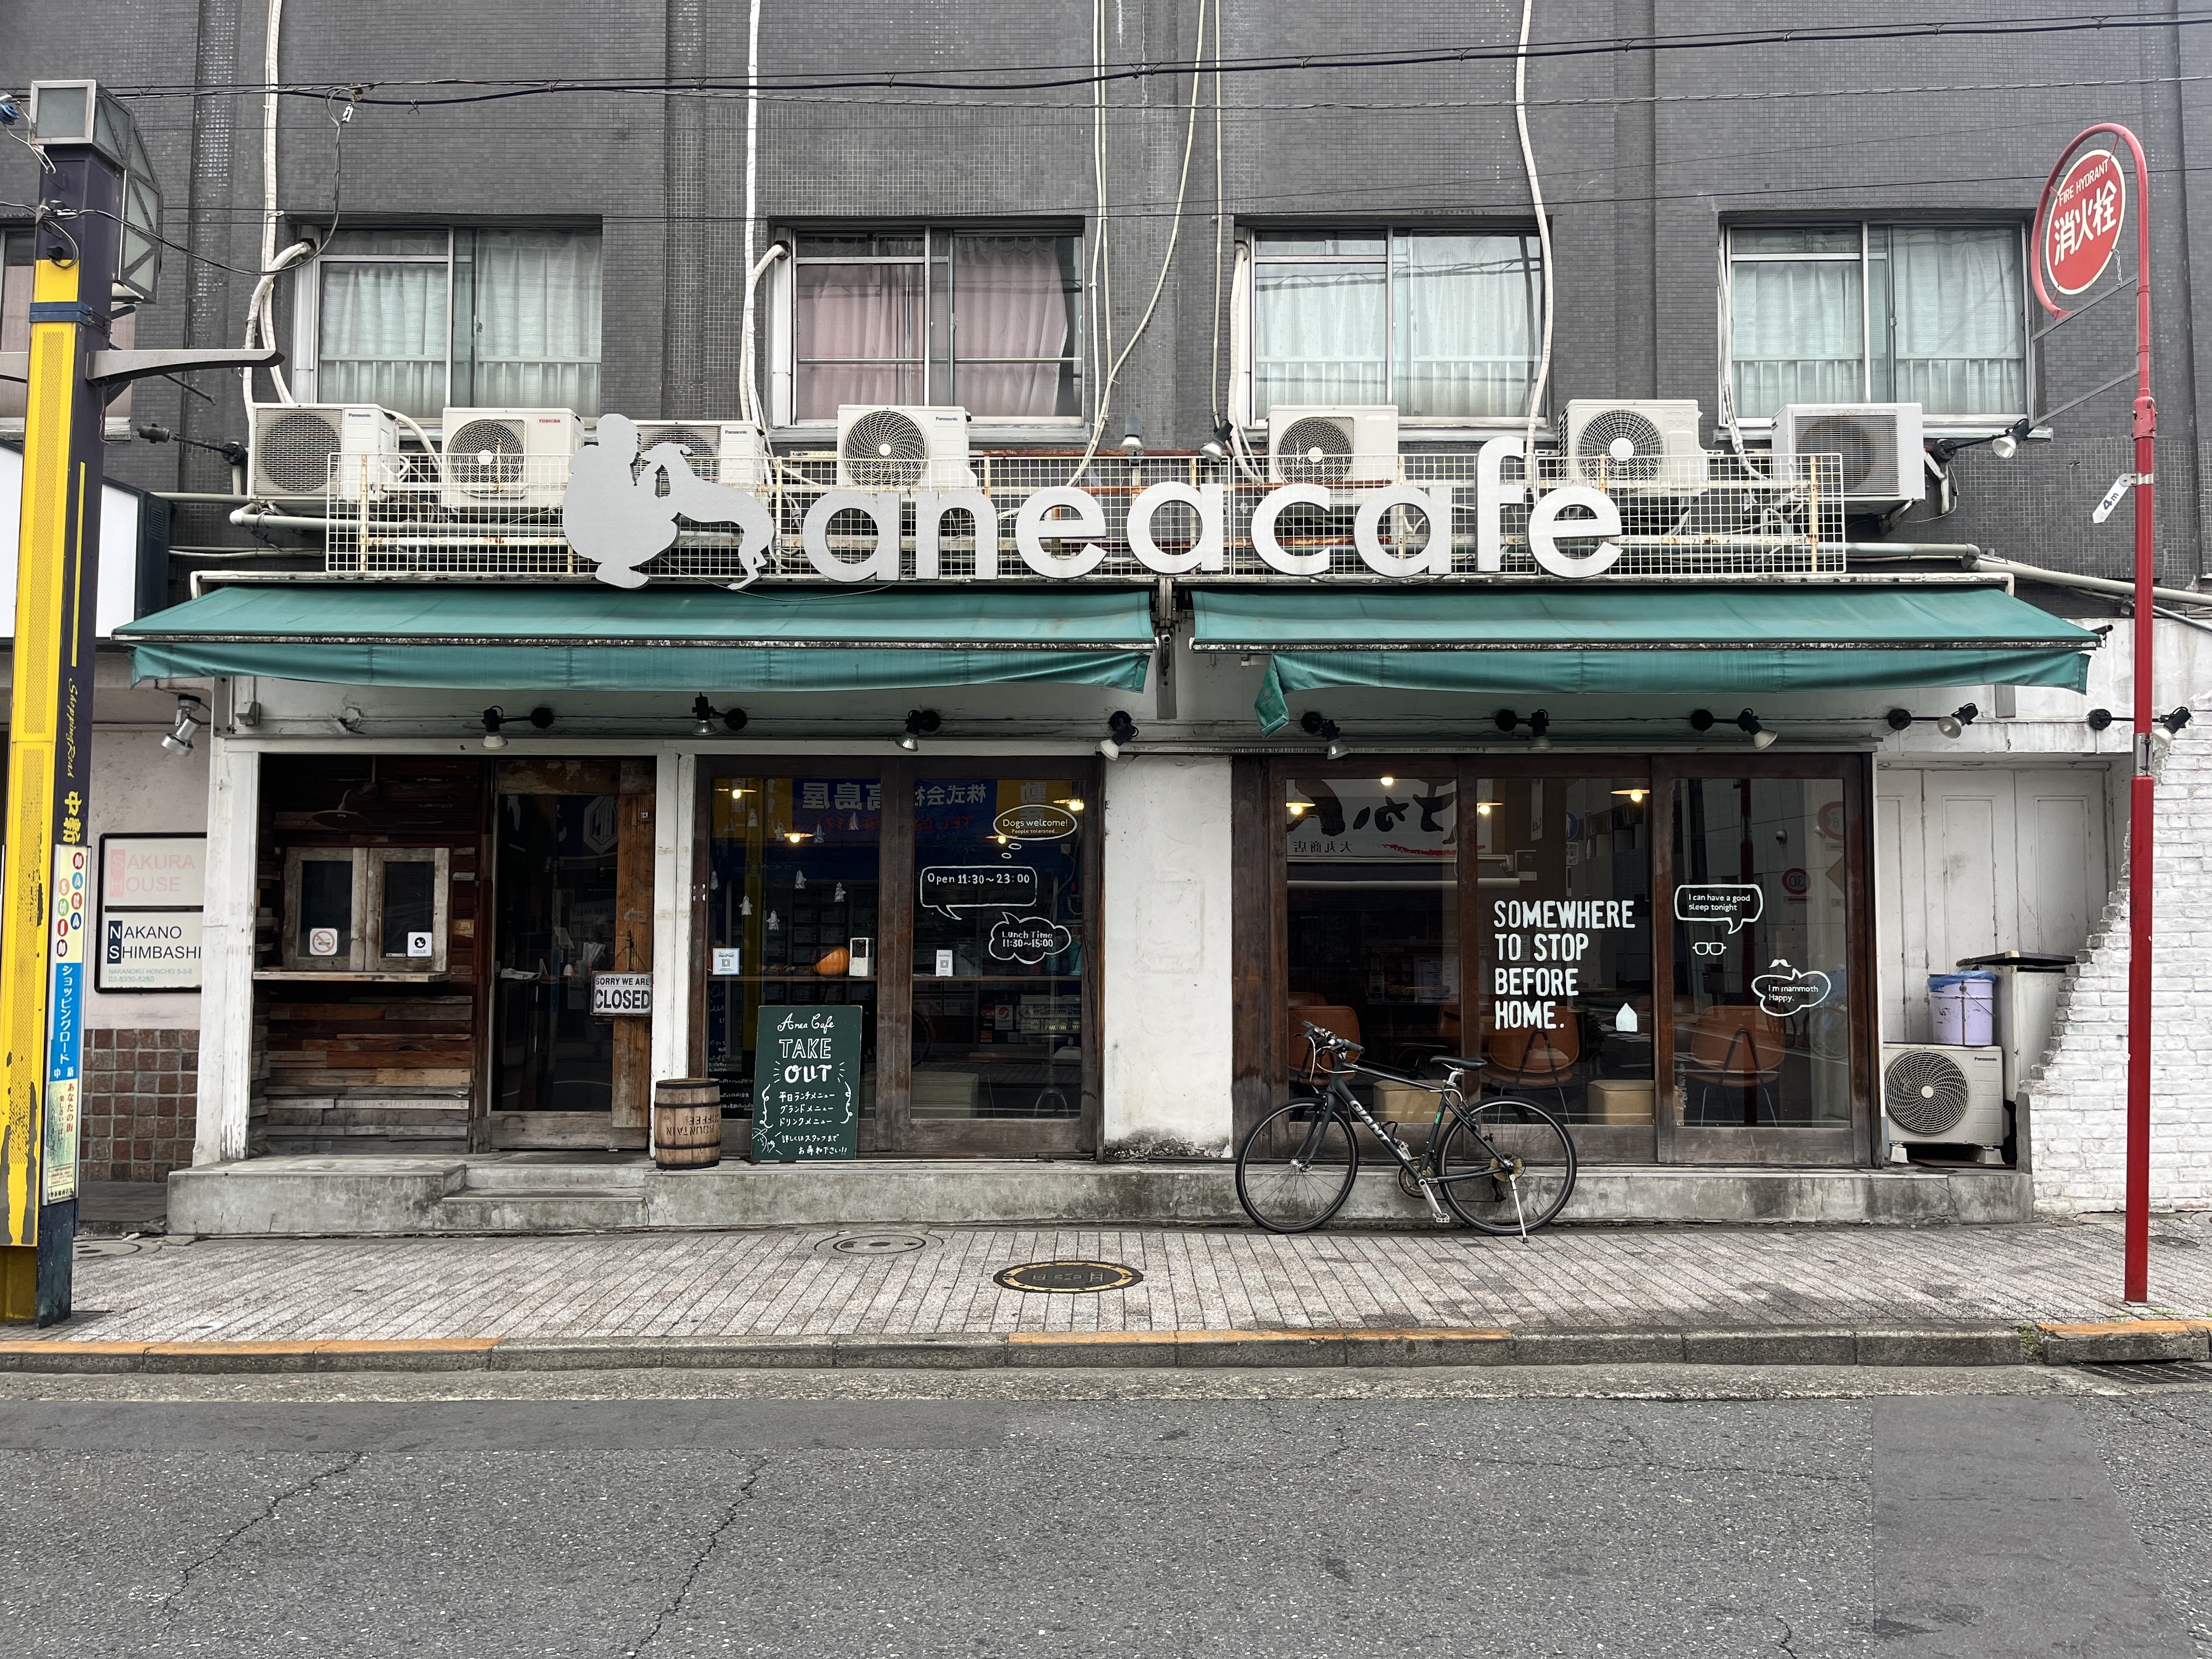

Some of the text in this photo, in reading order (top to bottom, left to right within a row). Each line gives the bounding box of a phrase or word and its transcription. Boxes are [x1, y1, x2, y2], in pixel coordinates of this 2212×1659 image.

[2059, 159, 2109, 207] FIRE HYDRANT
[2054, 179, 2117, 266] 消火栓
[63, 791, 82, 845] 中新
[1002, 819, 1068, 829] Dogs welcome!
[112, 854, 196, 870] SAKURA
[111, 876, 181, 893] HOUSE
[927, 873, 955, 885] Open
[1732, 894, 1751, 904] good
[1493, 900, 1636, 929] SOMEWHERE
[1689, 903, 1738, 912] sleep tonight
[109, 925, 182, 939] NAKANO
[1002, 930, 1053, 939] Lunch Time
[109, 945, 201, 960] SHIMBASHI
[1494, 933, 1589, 962] TO STOP
[635, 978, 650, 986] ARE
[1494, 967, 1579, 997] BEFORE
[595, 989, 651, 1009] CLOSED
[1769, 994, 1795, 1003] Happy.
[60, 964, 73, 1065] ショッピングロード
[1494, 1000, 1565, 1030] HOME.
[777, 1013, 835, 1034] Anea Cafe
[778, 1038, 832, 1059] TAKE
[785, 1064, 832, 1084] OUT
[778, 1091, 835, 1103] 平日ランチメニュー
[780, 1103, 834, 1114] グランドメニュー
[780, 1117, 832, 1127] ドリンクメニュー
[1349, 1099, 1391, 1142] GIANT
[667, 1124, 714, 1136] MOUNTAIN
[782, 1133, 840, 1144] 詳しくはスタッフまで
